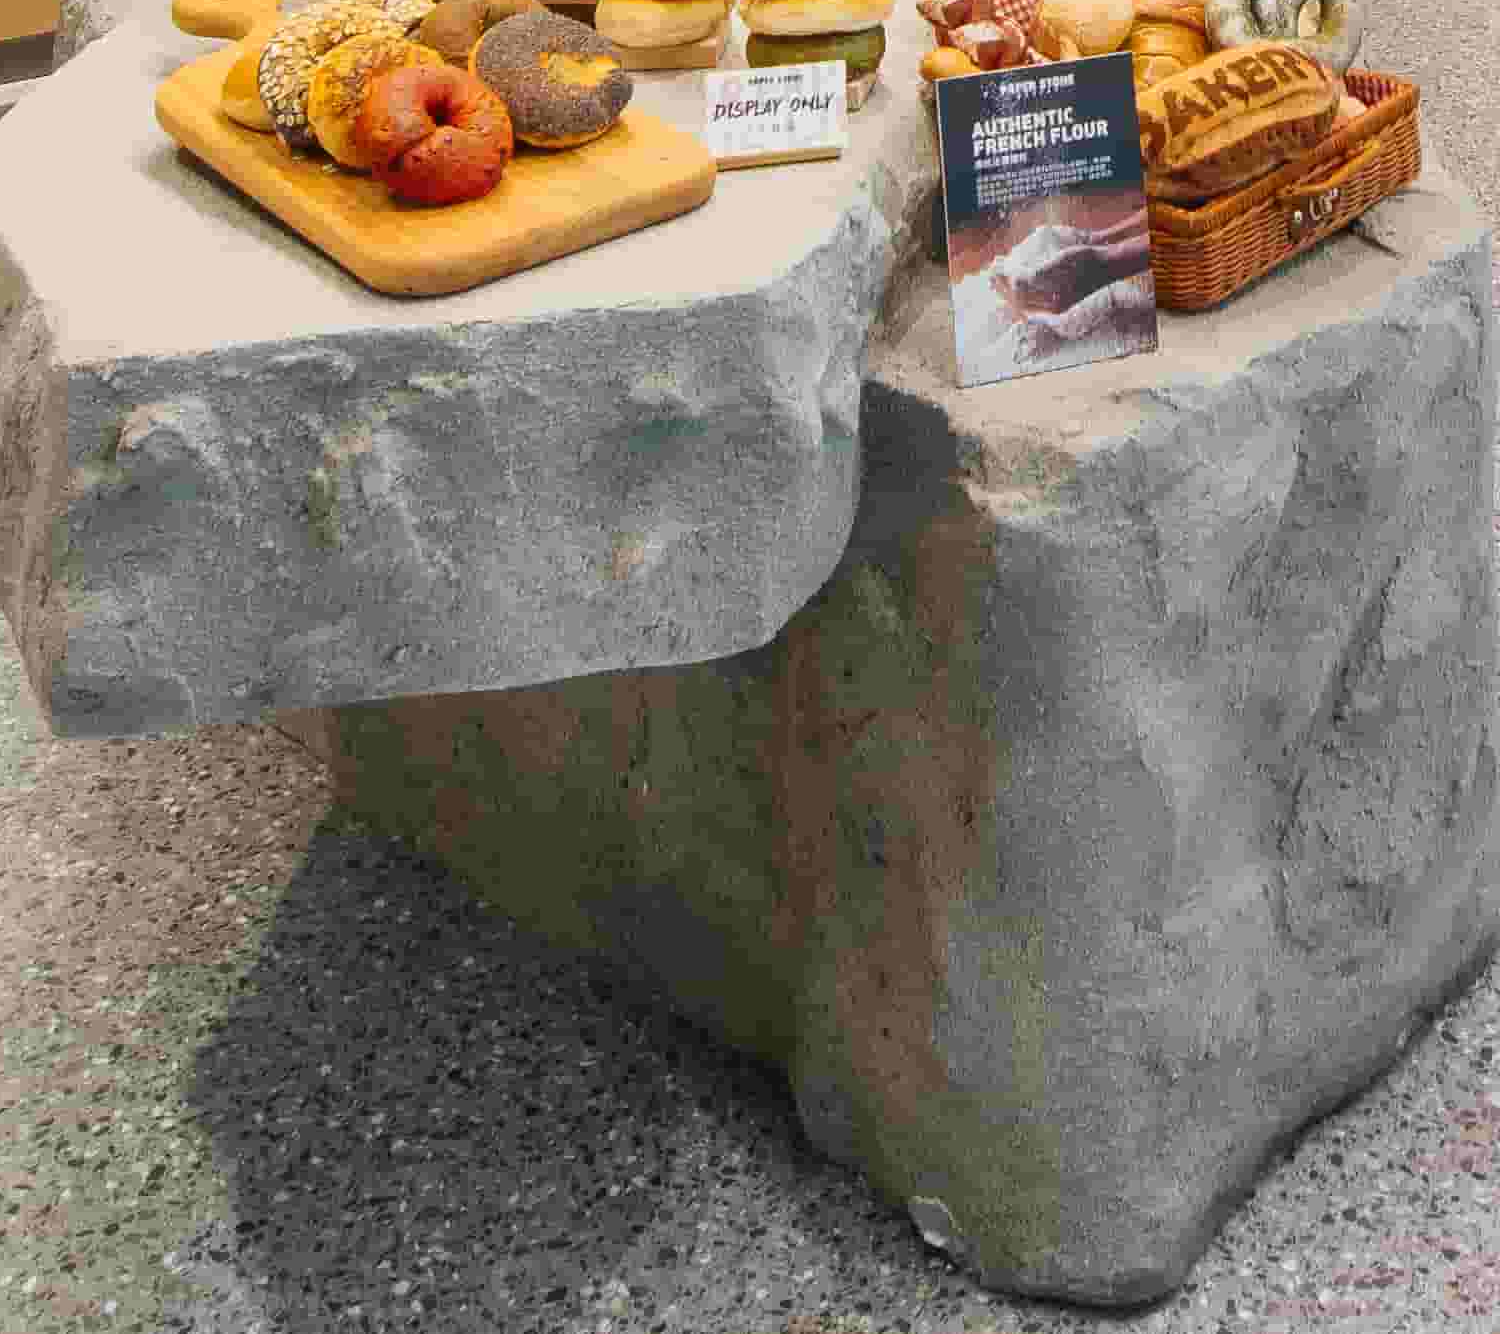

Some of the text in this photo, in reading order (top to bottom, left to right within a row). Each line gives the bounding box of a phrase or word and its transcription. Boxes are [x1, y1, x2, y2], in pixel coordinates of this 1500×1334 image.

[999, 79, 1037, 97] PAPER
[712, 91, 837, 123] DISPLAY ONLY
[971, 106, 1075, 140] AUTHENTIC
[972, 119, 1110, 159] FRENCH FLOUR
